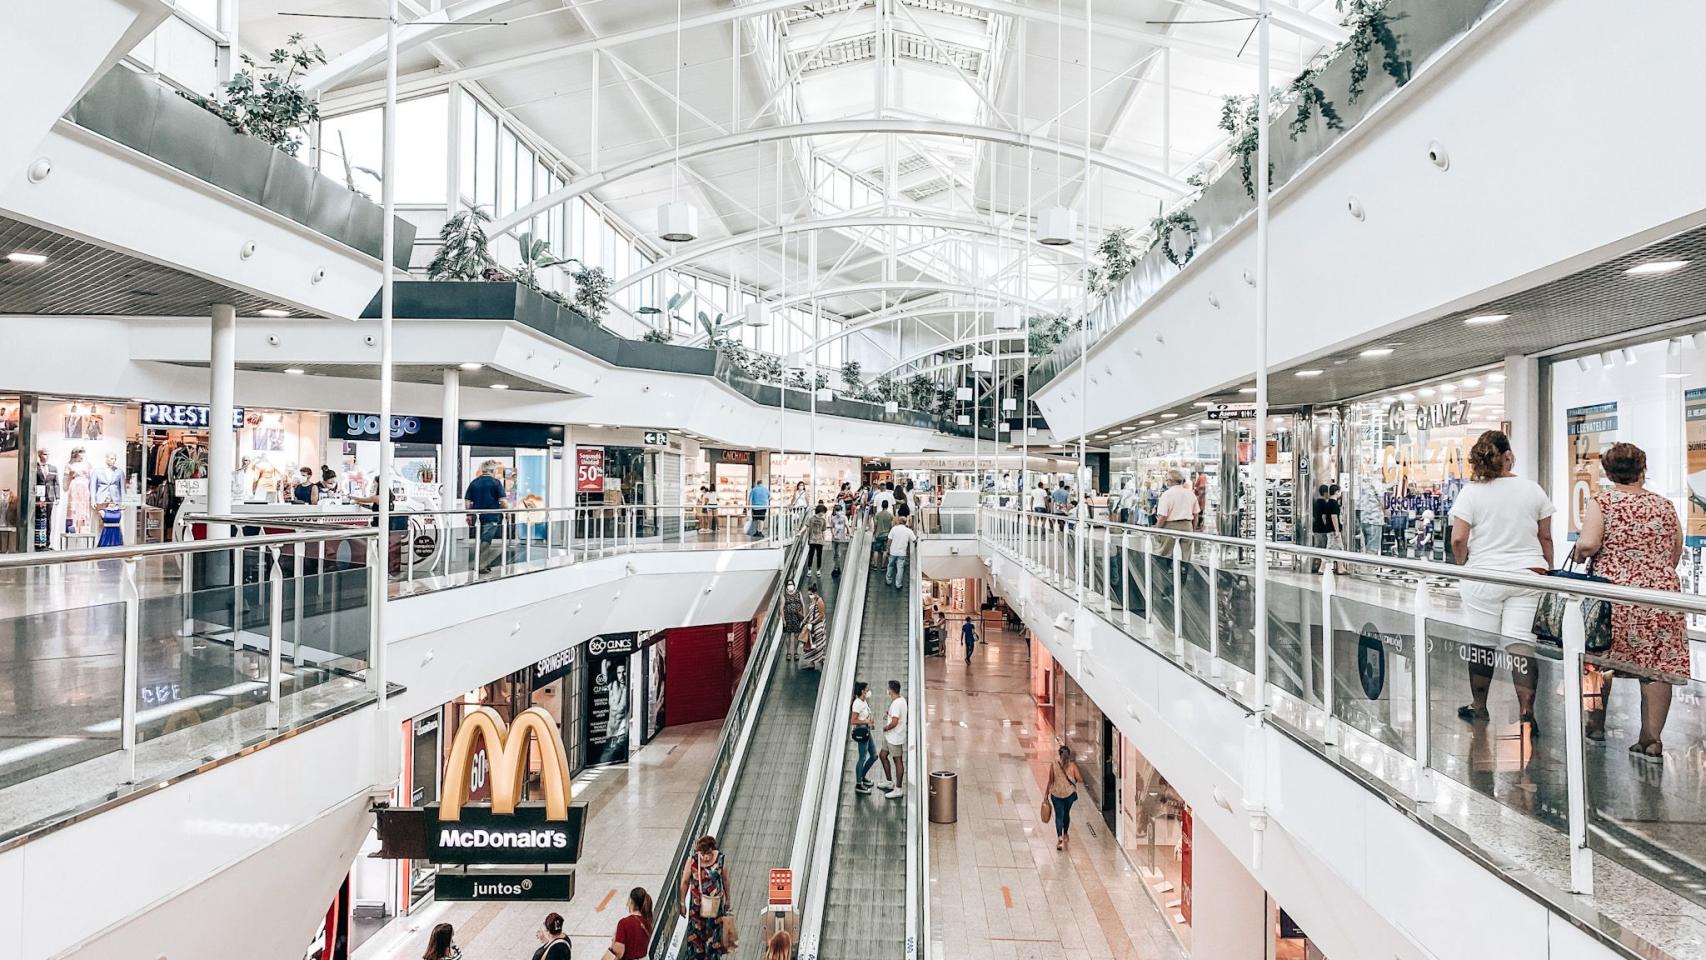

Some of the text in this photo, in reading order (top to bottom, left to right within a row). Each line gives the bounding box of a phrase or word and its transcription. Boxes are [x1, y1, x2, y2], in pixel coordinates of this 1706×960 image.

[144, 404, 243, 425] PRESTE
[1416, 400, 1471, 430] GALVEZ
[347, 414, 420, 438] yogo
[607, 639, 632, 649] CLINICS
[537, 647, 575, 678] SPRINGFIELD
[439, 829, 567, 848] McDonald's
[472, 882, 522, 897] juntos
